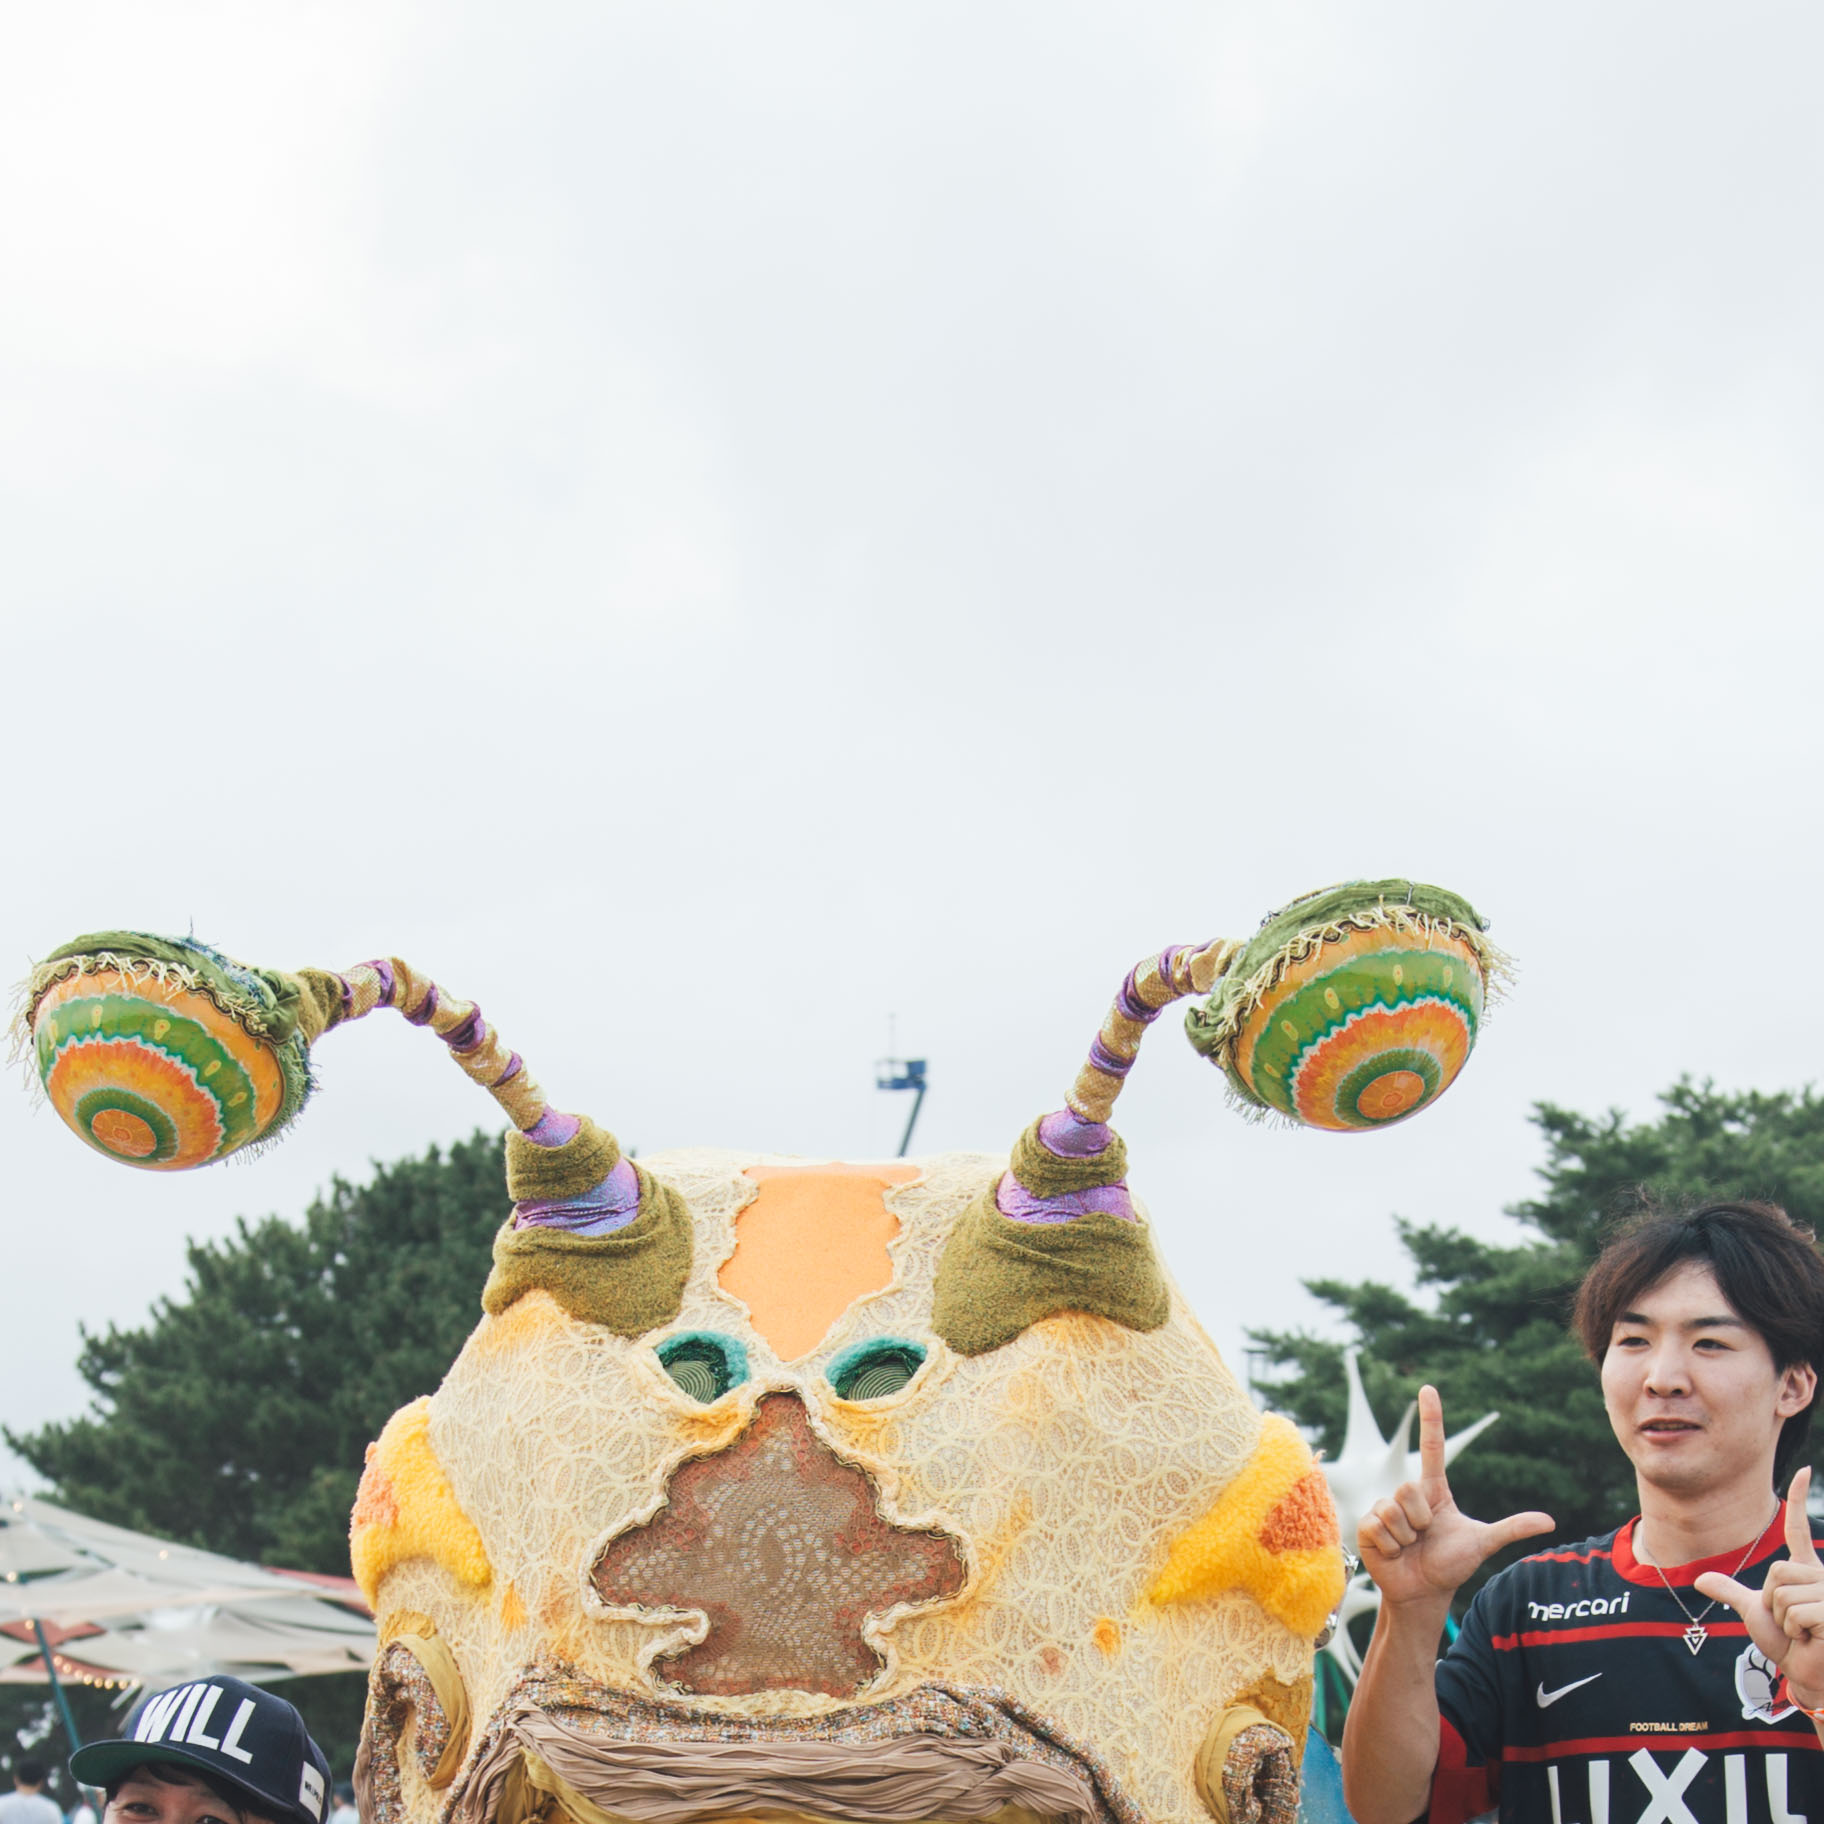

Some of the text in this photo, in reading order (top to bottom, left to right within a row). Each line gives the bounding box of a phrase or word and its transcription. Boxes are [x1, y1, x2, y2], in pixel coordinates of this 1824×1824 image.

[1528, 1591, 1631, 1622] mercari
[134, 1683, 257, 1765] WILL
[1629, 1720, 1709, 1732] FOOTBALL DREAM
